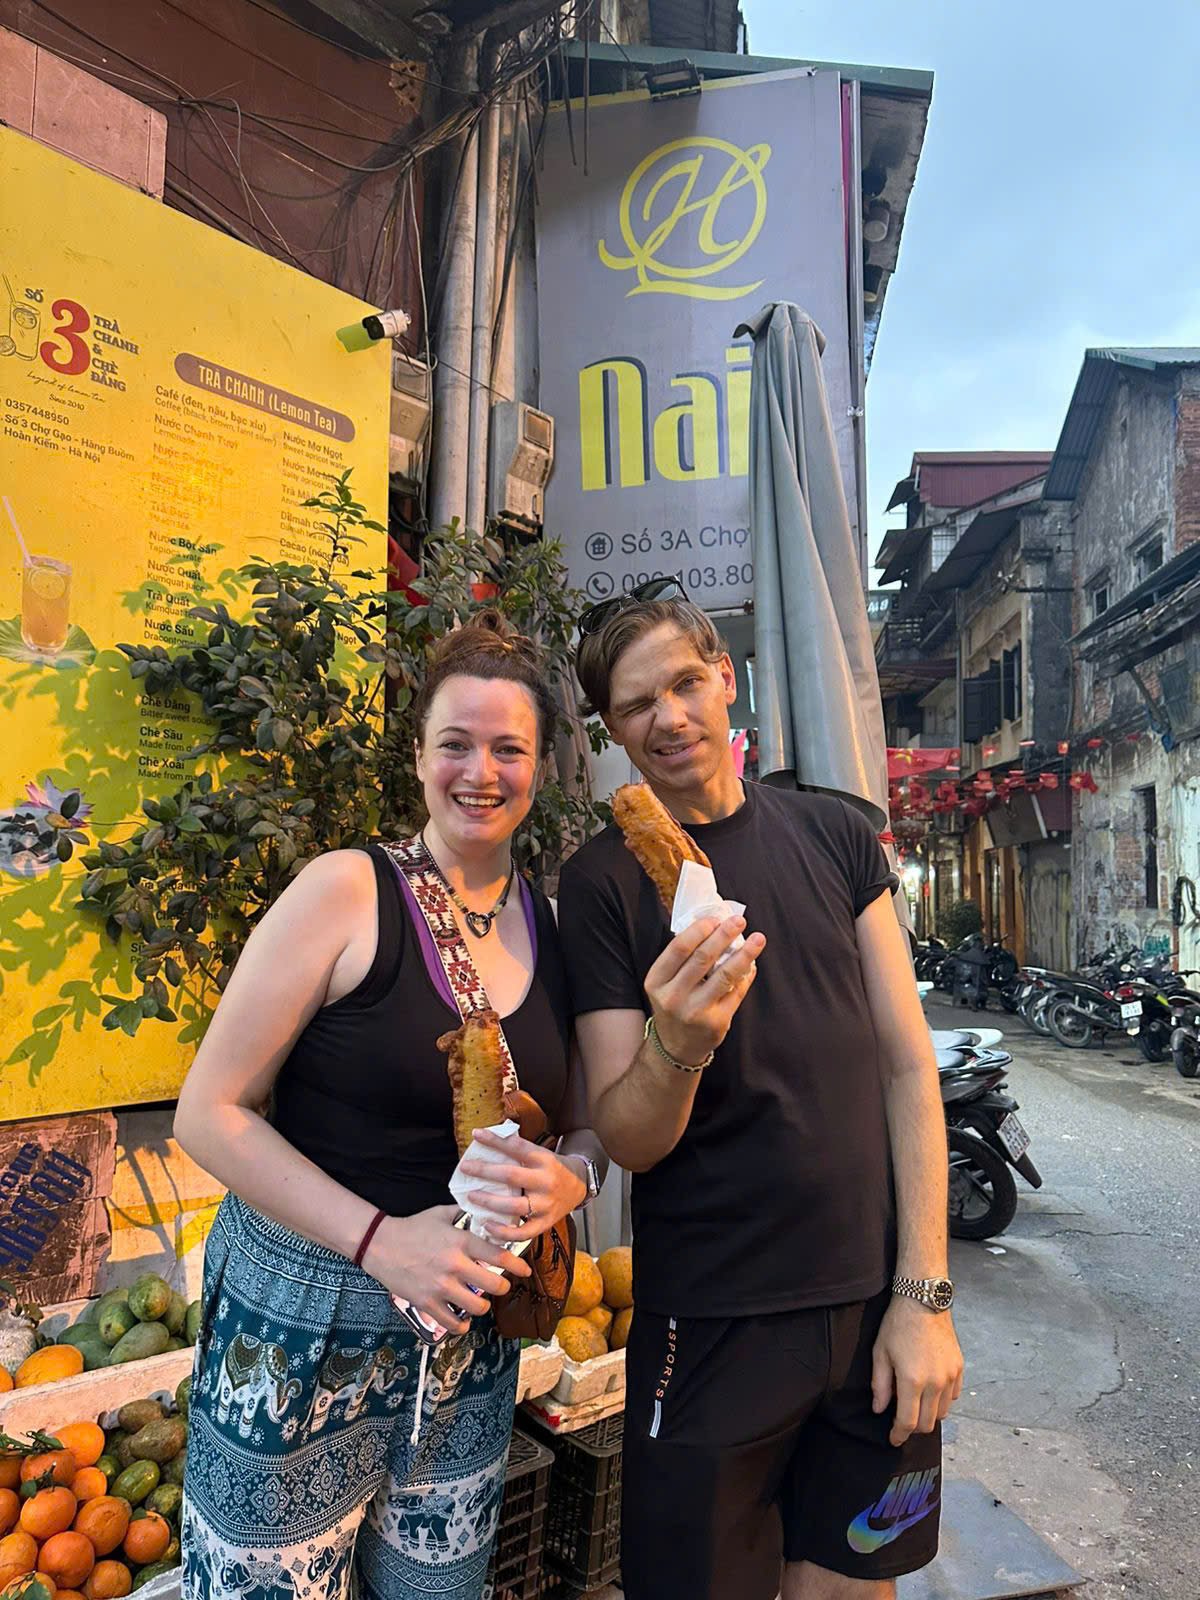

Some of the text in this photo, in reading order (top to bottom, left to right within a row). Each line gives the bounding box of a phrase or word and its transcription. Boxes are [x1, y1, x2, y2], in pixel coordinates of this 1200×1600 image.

[40, 299, 91, 376] 3
[93, 315, 121, 335] TRÀ
[92, 343, 103, 356] &
[93, 331, 140, 356] CHANH
[91, 357, 118, 375] CHÈ
[5, 398, 70, 426] 0357448950
[198, 365, 336, 434] TRÀ CHANH (Lemon Tea)
[4, 427, 31, 442] Hoàn
[69, 447, 82, 459] Hà
[21, 418, 28, 428] 3
[81, 438, 106, 455] Hàng
[621, 525, 750, 554] Số 3A Chợ
[146, 589, 163, 601] Trà
[165, 742, 185, 752] from
[164, 770, 184, 780] from
[656, 1331, 677, 1398] SPORTS
[870, 1465, 940, 1519] NIKE
